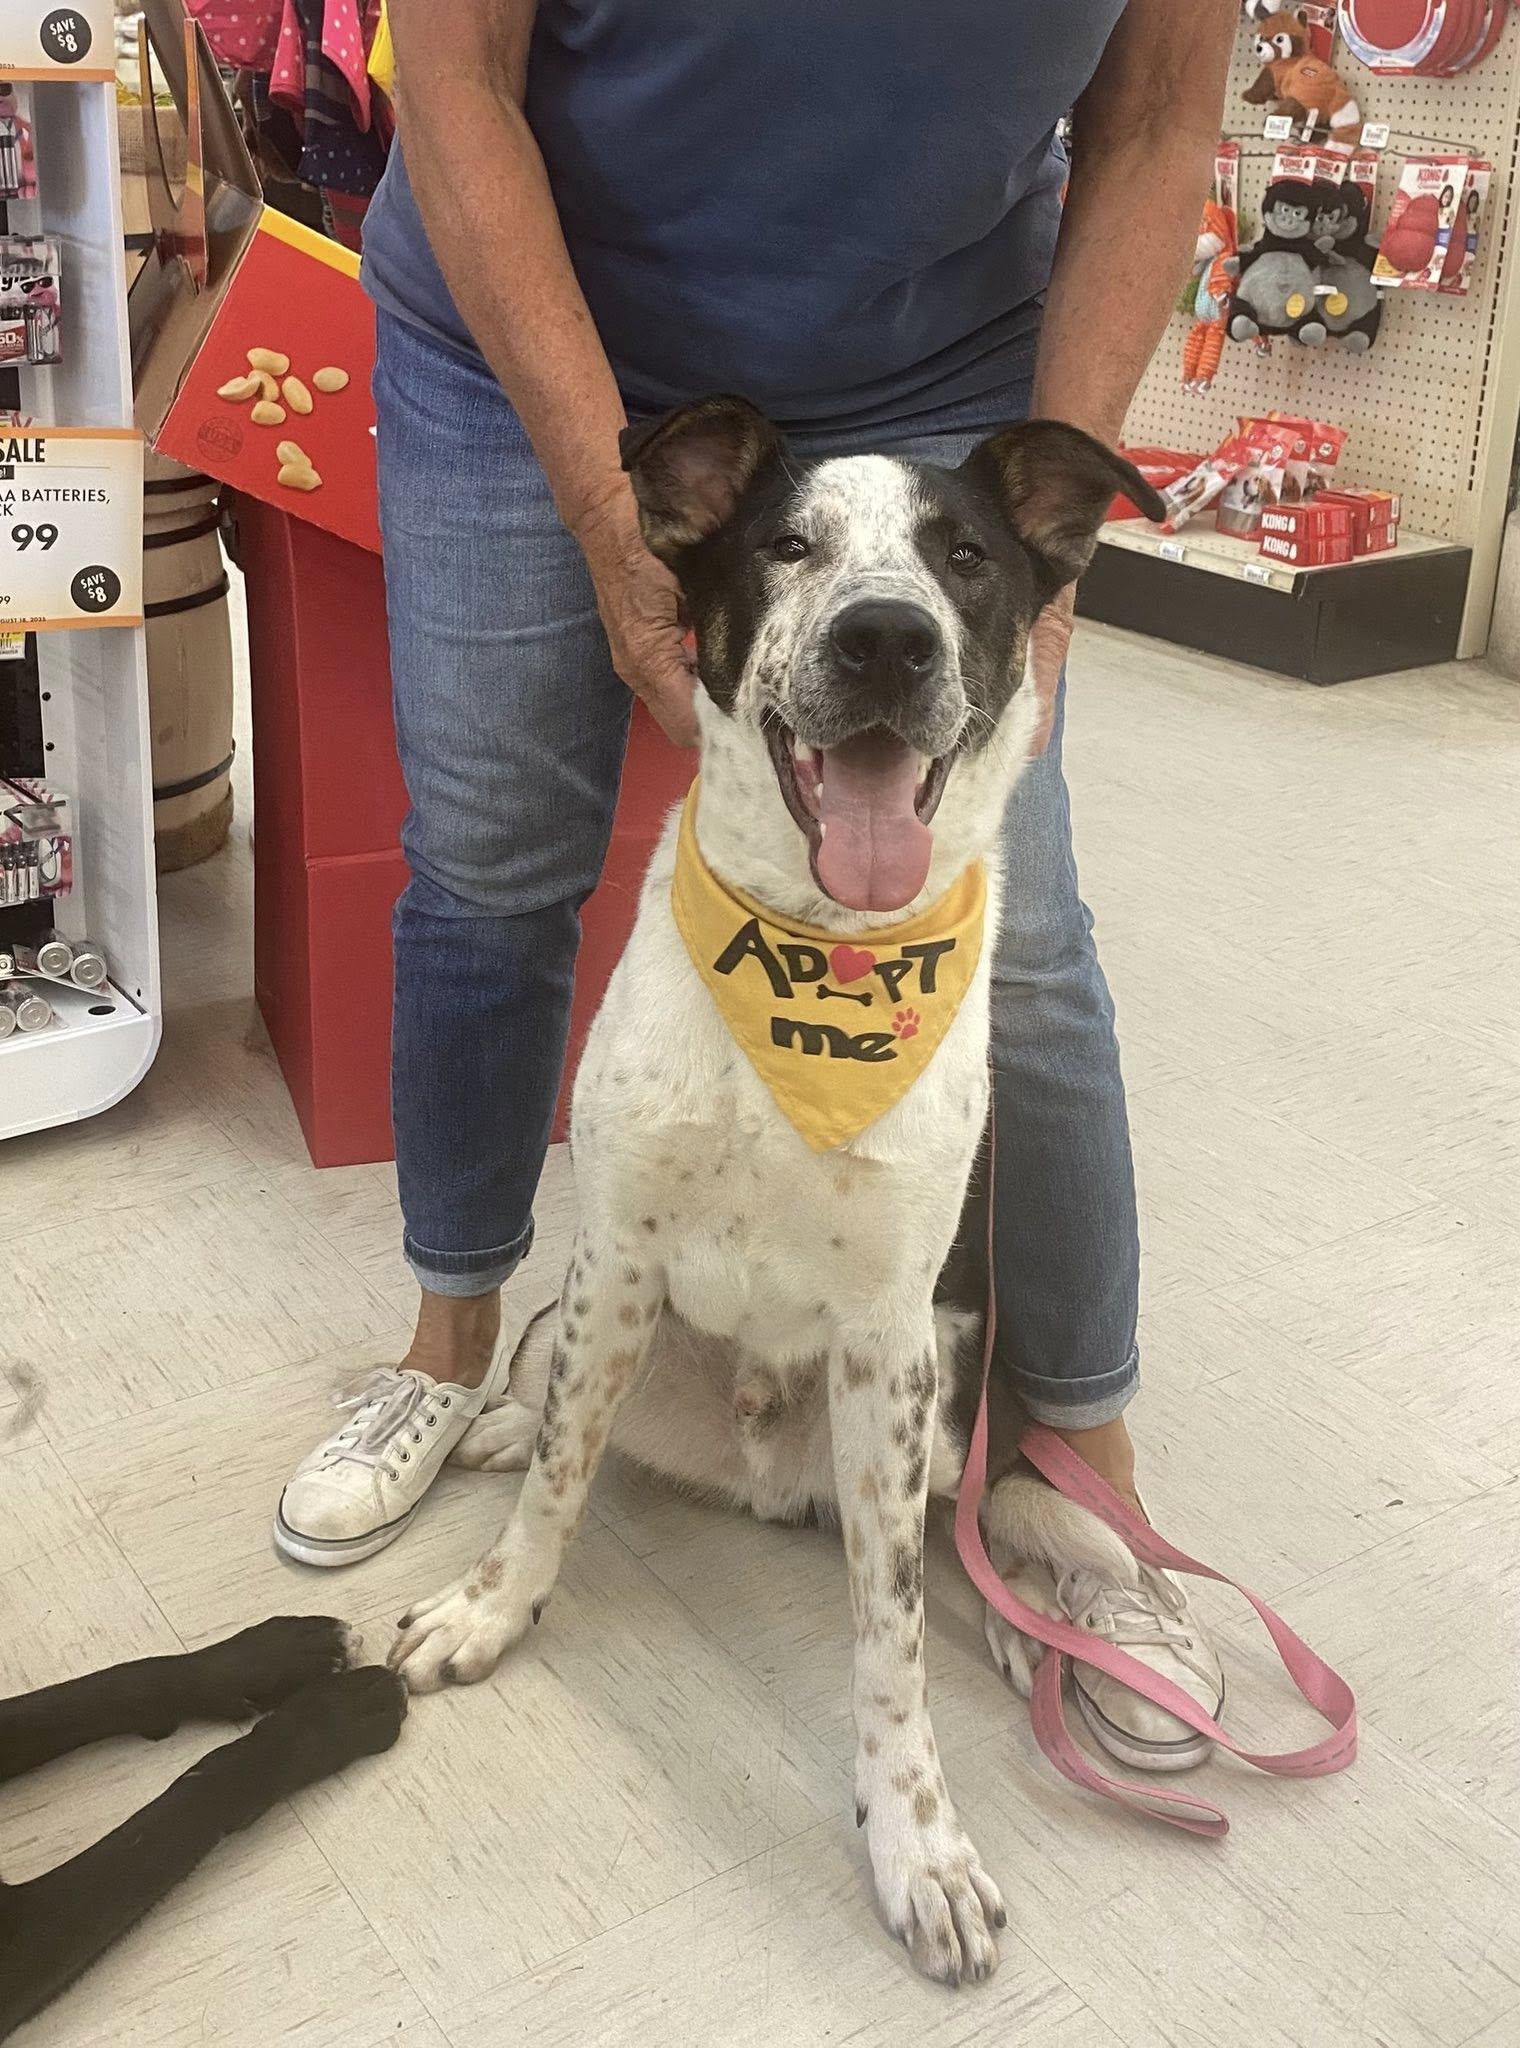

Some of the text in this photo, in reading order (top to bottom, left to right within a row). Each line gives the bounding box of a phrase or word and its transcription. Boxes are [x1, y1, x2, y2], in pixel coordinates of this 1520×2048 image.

[49, 18, 76, 35] SAVE
[57, 33, 78, 52] $8
[22, 488, 110, 504] BATTERIES,
[0, 504, 14, 516] K
[1261, 512, 1289, 532] KONG
[11, 523, 59, 551] 99
[1262, 535, 1290, 557] KONG
[80, 572, 106, 589] SAVE
[87, 586, 107, 603] $8
[770, 1016, 899, 1063] me
